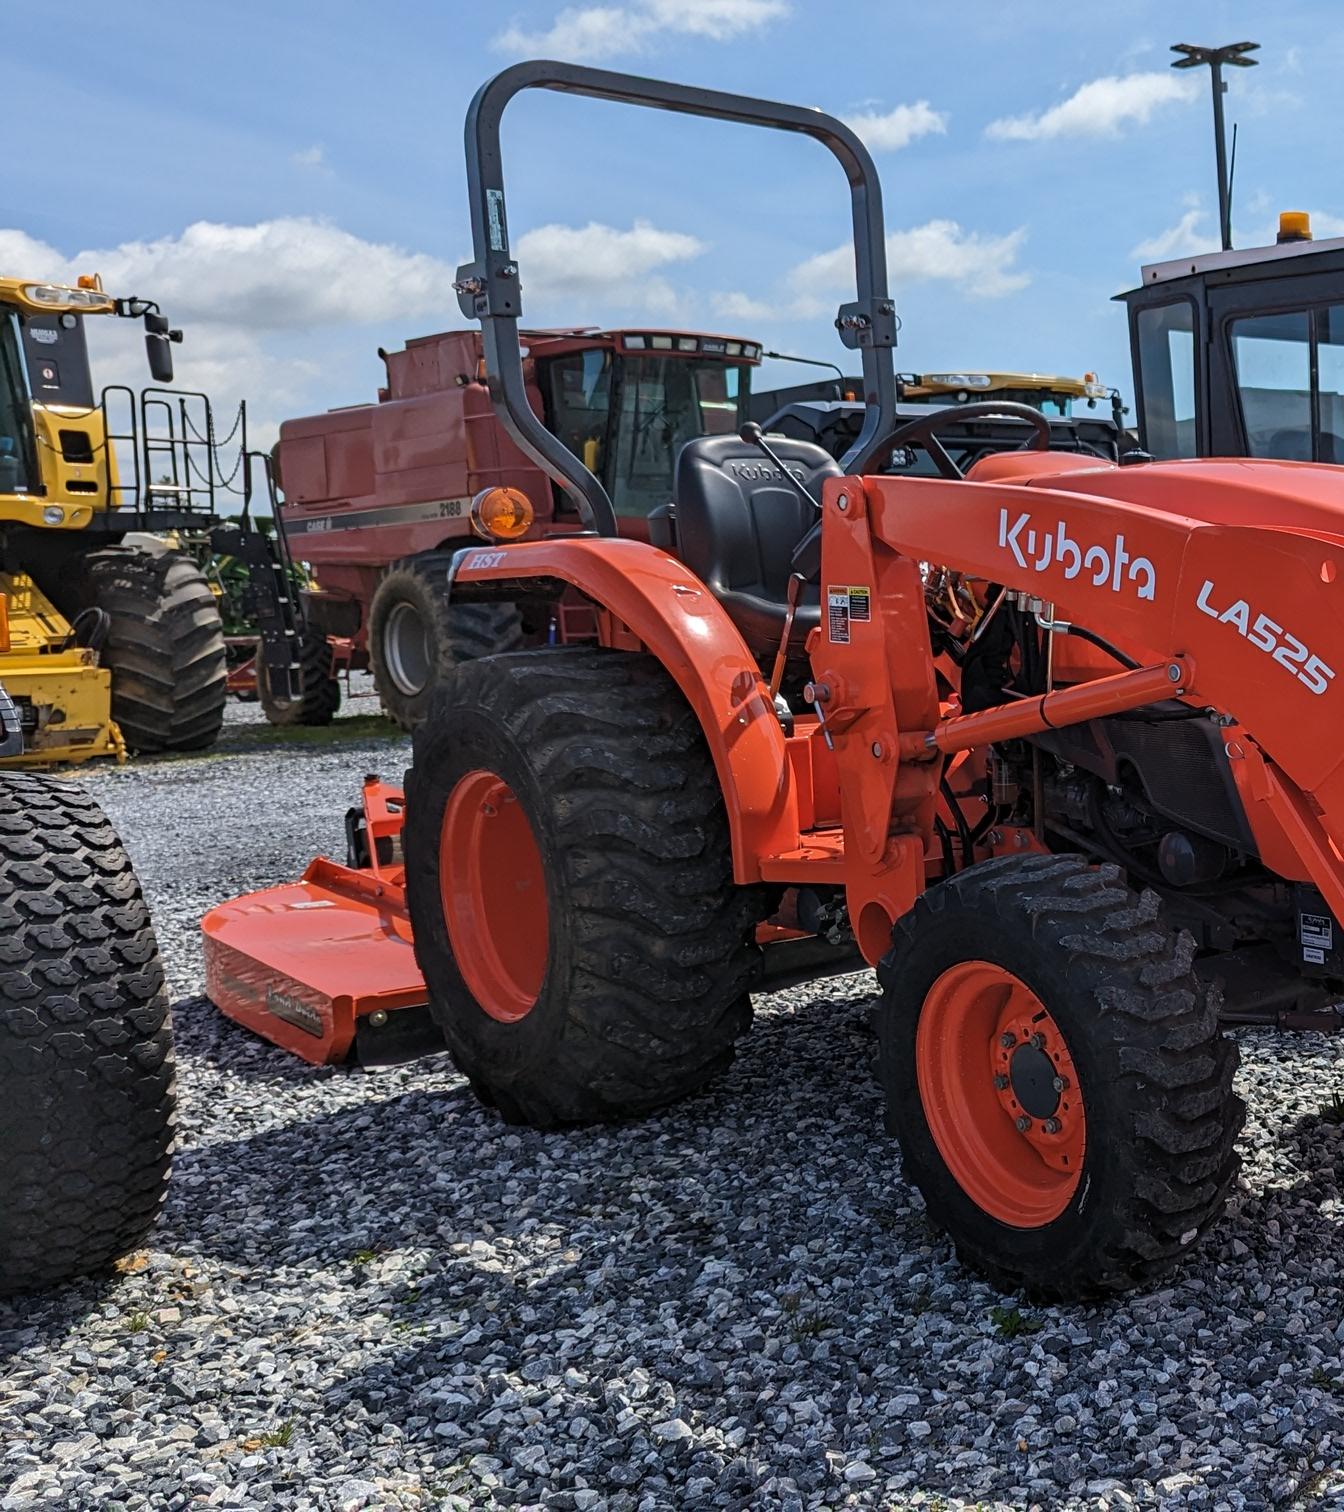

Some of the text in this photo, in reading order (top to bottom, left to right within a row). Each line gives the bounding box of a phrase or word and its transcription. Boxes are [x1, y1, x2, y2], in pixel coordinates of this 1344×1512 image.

[467, 551, 508, 570] HST
[998, 508, 1156, 601] Kubota
[1196, 579, 1336, 695] LA525
